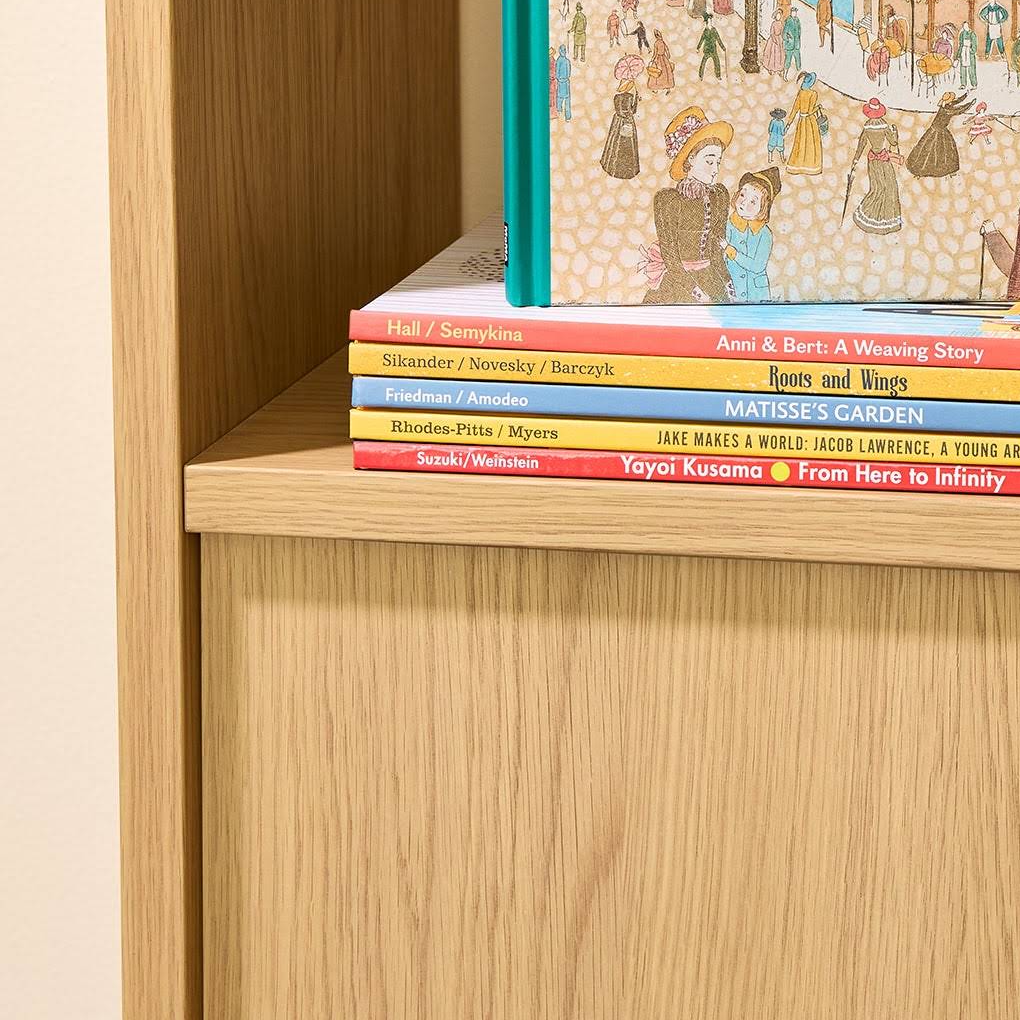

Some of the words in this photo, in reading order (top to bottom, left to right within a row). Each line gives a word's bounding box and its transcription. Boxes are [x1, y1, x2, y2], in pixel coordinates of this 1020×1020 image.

[387, 320, 421, 335] Hall
[440, 322, 523, 344] Semykina
[716, 335, 758, 352] Anni
[762, 336, 778, 353] &
[783, 337, 828, 354] Bert:
[835, 341, 849, 355] A
[854, 341, 929, 360] Weaving
[934, 342, 984, 362] Story
[383, 353, 454, 369] Sikander
[469, 357, 536, 375] Novesky
[551, 360, 615, 378] Barczyk
[769, 365, 812, 392] Roots
[822, 369, 851, 389] and
[862, 370, 908, 397] Wings
[385, 387, 452, 405] Friedman
[467, 391, 528, 408] Amodeo
[834, 405, 924, 424] GARDEN
[391, 420, 493, 438] Rhodes-Pitts
[508, 425, 559, 443] Myers
[657, 430, 688, 447] JAKE
[693, 431, 739, 449] MAKES
[745, 434, 753, 449] A
[758, 434, 808, 451] WORLD:
[813, 436, 853, 452] JACOB
[859, 438, 936, 457] LAWRENCE,
[940, 441, 949, 457] A
[954, 441, 999, 458] YOUNG
[416, 451, 539, 470] Suzuki/Weinstein
[621, 454, 676, 480] Yayoi
[683, 457, 762, 479] Kusama
[799, 462, 849, 483] From
[855, 465, 902, 485] Here
[908, 468, 929, 486] to
[934, 468, 1006, 493] Infinity
